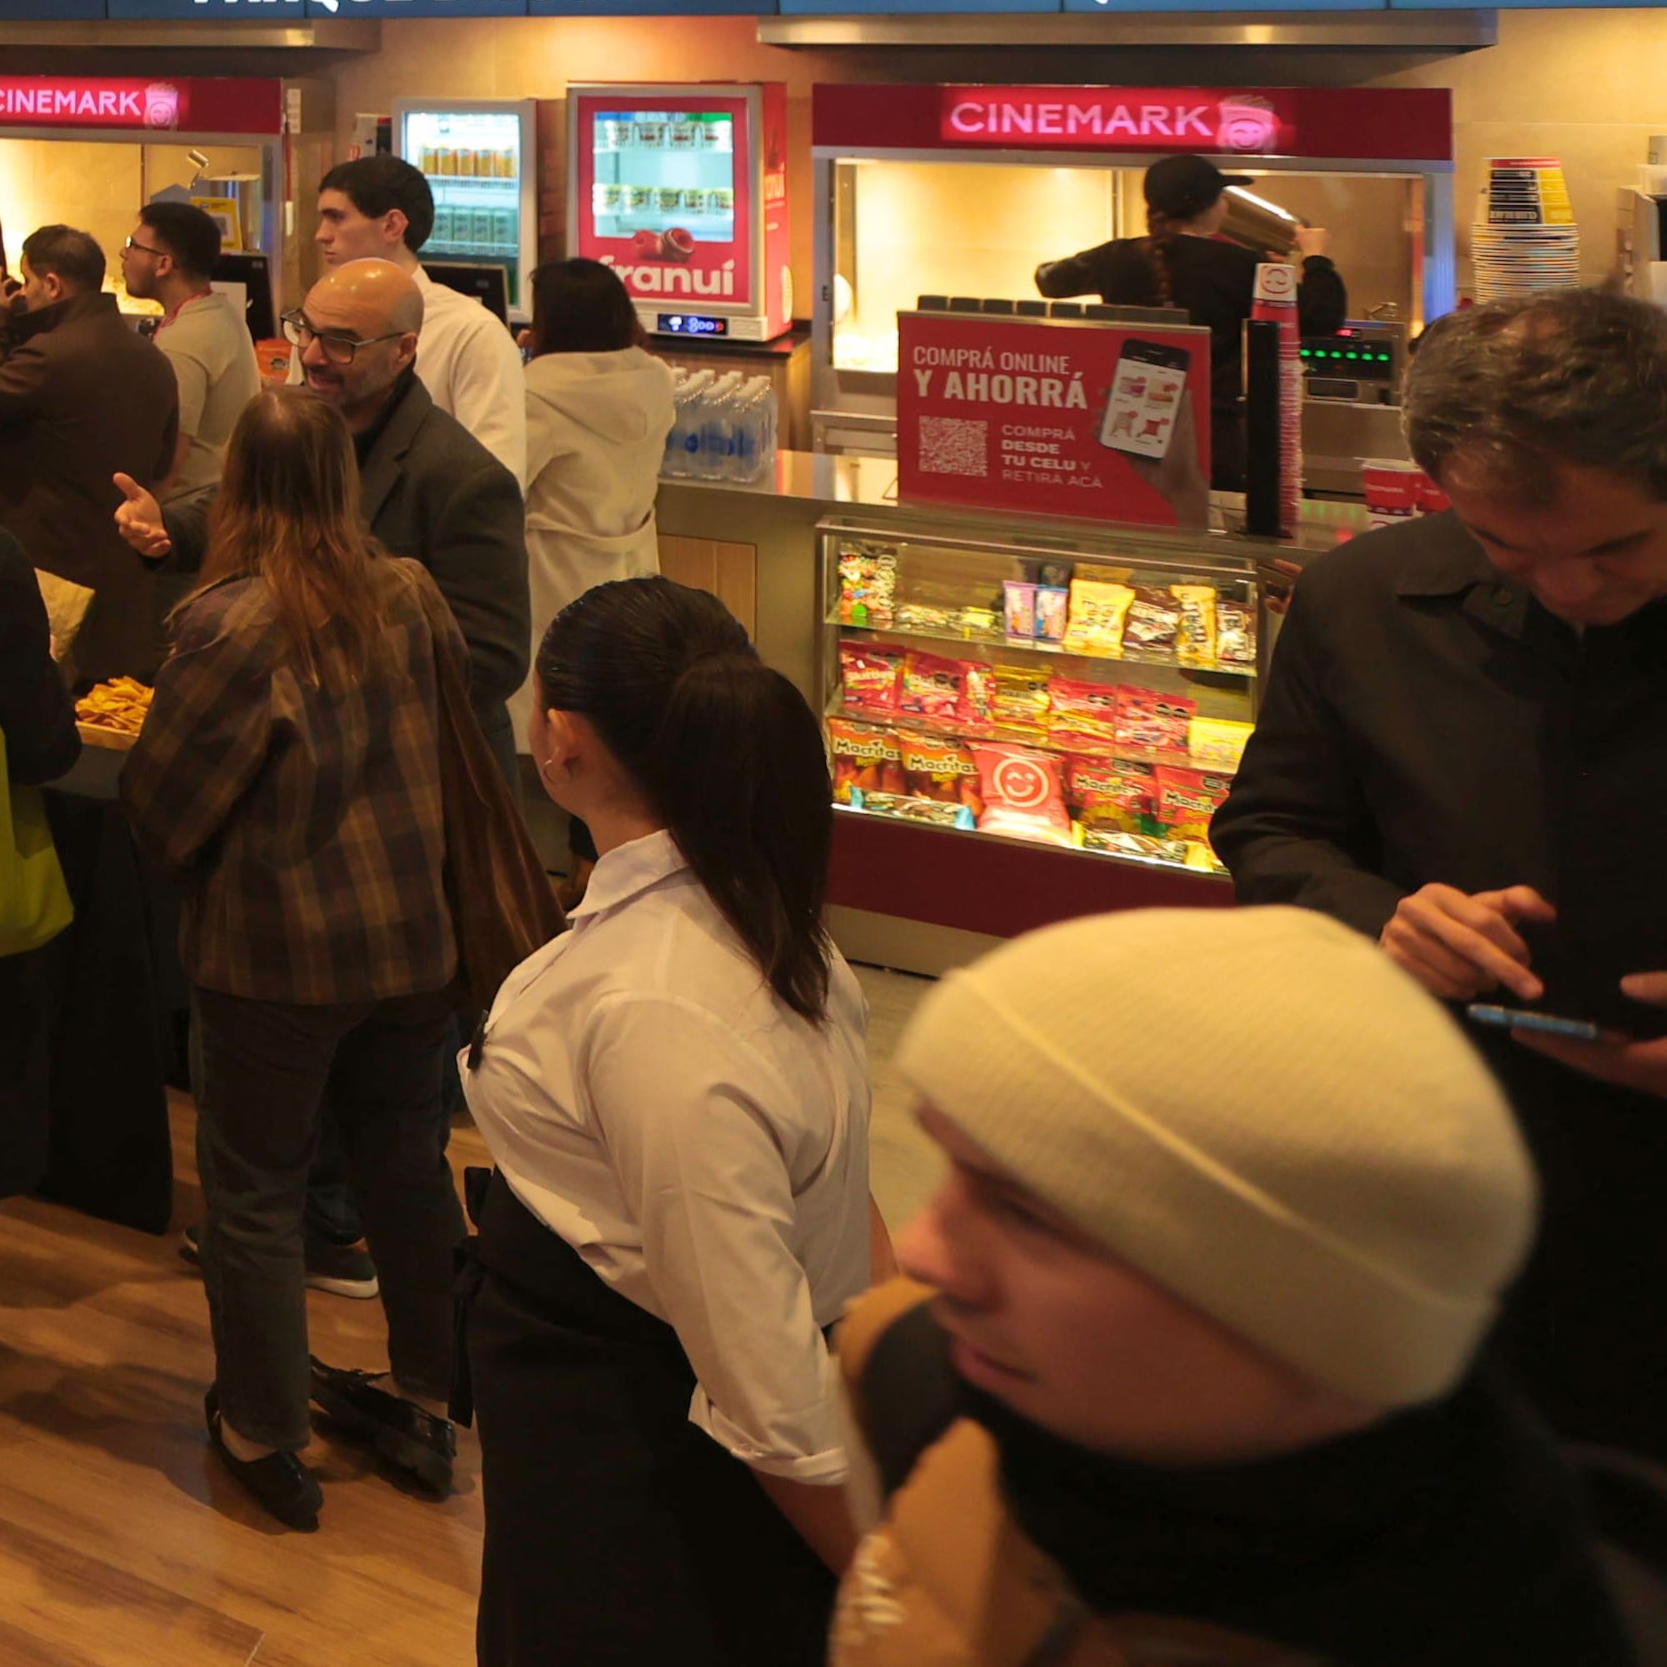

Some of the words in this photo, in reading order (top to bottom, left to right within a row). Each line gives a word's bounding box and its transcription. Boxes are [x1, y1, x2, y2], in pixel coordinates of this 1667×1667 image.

[950, 102, 1214, 136] CINEMARK
[913, 346, 995, 370] COMPRÁ
[1000, 351, 1071, 376] ONLINE
[913, 369, 933, 398] Y
[944, 372, 1088, 410] AHORRÁ
[1001, 439, 1060, 454] DESDE
[1001, 454, 1026, 467] TU
[1030, 457, 1076, 471] CELU
[1081, 462, 1091, 472] Y
[833, 738, 901, 761] Macritas
[908, 755, 979, 775] Macritas
